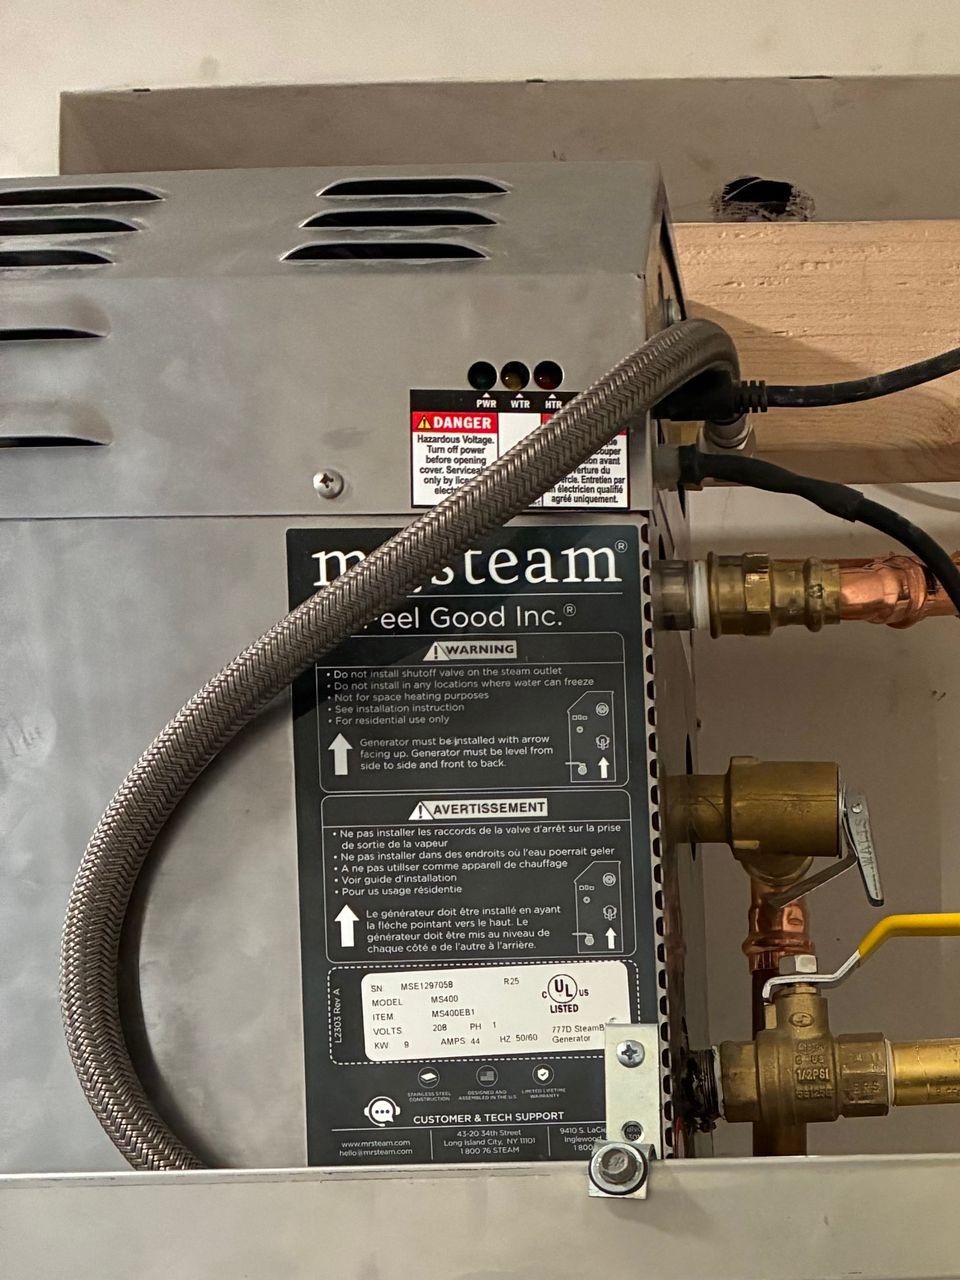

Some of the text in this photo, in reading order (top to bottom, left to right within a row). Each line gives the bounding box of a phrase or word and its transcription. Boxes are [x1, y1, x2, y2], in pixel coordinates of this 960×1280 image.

[476, 400, 497, 408] PWR
[545, 401, 562, 409] HTR
[433, 416, 492, 429] DANGER
[417, 434, 495, 446] Hazardous Voltage.
[427, 445, 486, 456] Turn off power
[426, 455, 486, 466] before opening
[420, 466, 444, 474] cover.
[600, 466, 610, 474] du
[424, 476, 441, 486] only
[444, 476, 453, 486] by
[581, 476, 612, 484] Entretien
[614, 477, 625, 486] par
[558, 484, 595, 494] électricien
[596, 485, 624, 495] qualifié
[552, 494, 572, 504] agréé
[574, 495, 619, 504] uniquement.
[363, 606, 420, 629] eel
[430, 606, 505, 628] Good
[446, 644, 515, 656] WARNING
[334, 670, 348, 679] Do
[351, 670, 367, 678] not
[371, 669, 399, 678] install
[402, 668, 436, 678] shutoff
[440, 668, 464, 677] valve
[483, 668, 500, 676] the
[502, 668, 530, 676] steam
[534, 666, 562, 675] outlet
[334, 682, 348, 690] Do
[352, 682, 368, 690] not
[371, 680, 400, 690] install
[402, 680, 411, 688] in
[414, 681, 432, 692] any
[434, 680, 478, 688] locations
[482, 680, 511, 688] where
[514, 679, 541, 687] water
[564, 678, 594, 686] freeze
[334, 691, 490, 704] Not for space heating purposes
[335, 703, 464, 714] See installation instruction
[336, 716, 352, 725] For
[355, 715, 406, 724] residential
[428, 714, 450, 724] only
[360, 738, 408, 747] Generator
[412, 737, 436, 746] must
[440, 736, 452, 746] be
[498, 736, 520, 744] with
[522, 736, 550, 744] arrow
[433, 801, 546, 816] AVERTISSEMENT
[340, 830, 354, 838] Ne
[356, 830, 374, 840] pas
[377, 828, 415, 837] installer
[418, 828, 432, 836] les
[434, 827, 476, 836] raccords
[479, 826, 492, 834] de
[494, 826, 502, 834] la
[506, 825, 530, 834] valve
[586, 824, 594, 832] la
[342, 876, 362, 884] Voir
[364, 876, 392, 886] guide
[342, 888, 365, 896] Pour
[368, 887, 380, 896] us
[382, 887, 412, 896] usage
[366, 905, 560, 920] Le générateur doit être installé en ayant
[370, 984, 382, 993] SN
[504, 978, 520, 986] R25
[554, 979, 573, 998] UL
[579, 988, 589, 996] US
[333, 988, 340, 996] A
[372, 994, 458, 1008] MODEL MS400
[372, 1008, 474, 1021] ITEM MS400EB1
[550, 1004, 578, 1014] LISTED
[334, 1016, 342, 1044] L2303
[373, 1026, 402, 1036] VOLTS
[432, 1024, 448, 1032] 208
[470, 1022, 482, 1030] PH
[552, 1026, 572, 1034] 777D
[374, 1042, 388, 1050] KW
[440, 1037, 466, 1046] AMPS
[500, 1034, 512, 1043] HZ
[516, 1033, 538, 1042] 50/60
[552, 1034, 590, 1044] Generator
[414, 1111, 564, 1124] CUSTOMER & TECH SUPPORT
[456, 1129, 522, 1138] 43-20 34th Street
[560, 1126, 577, 1134] 9410
[342, 1140, 410, 1148] www.mrsteam.com
[444, 1140, 462, 1148] Long
[464, 1138, 486, 1146] Island
[494, 1146, 520, 1154] STEAM
